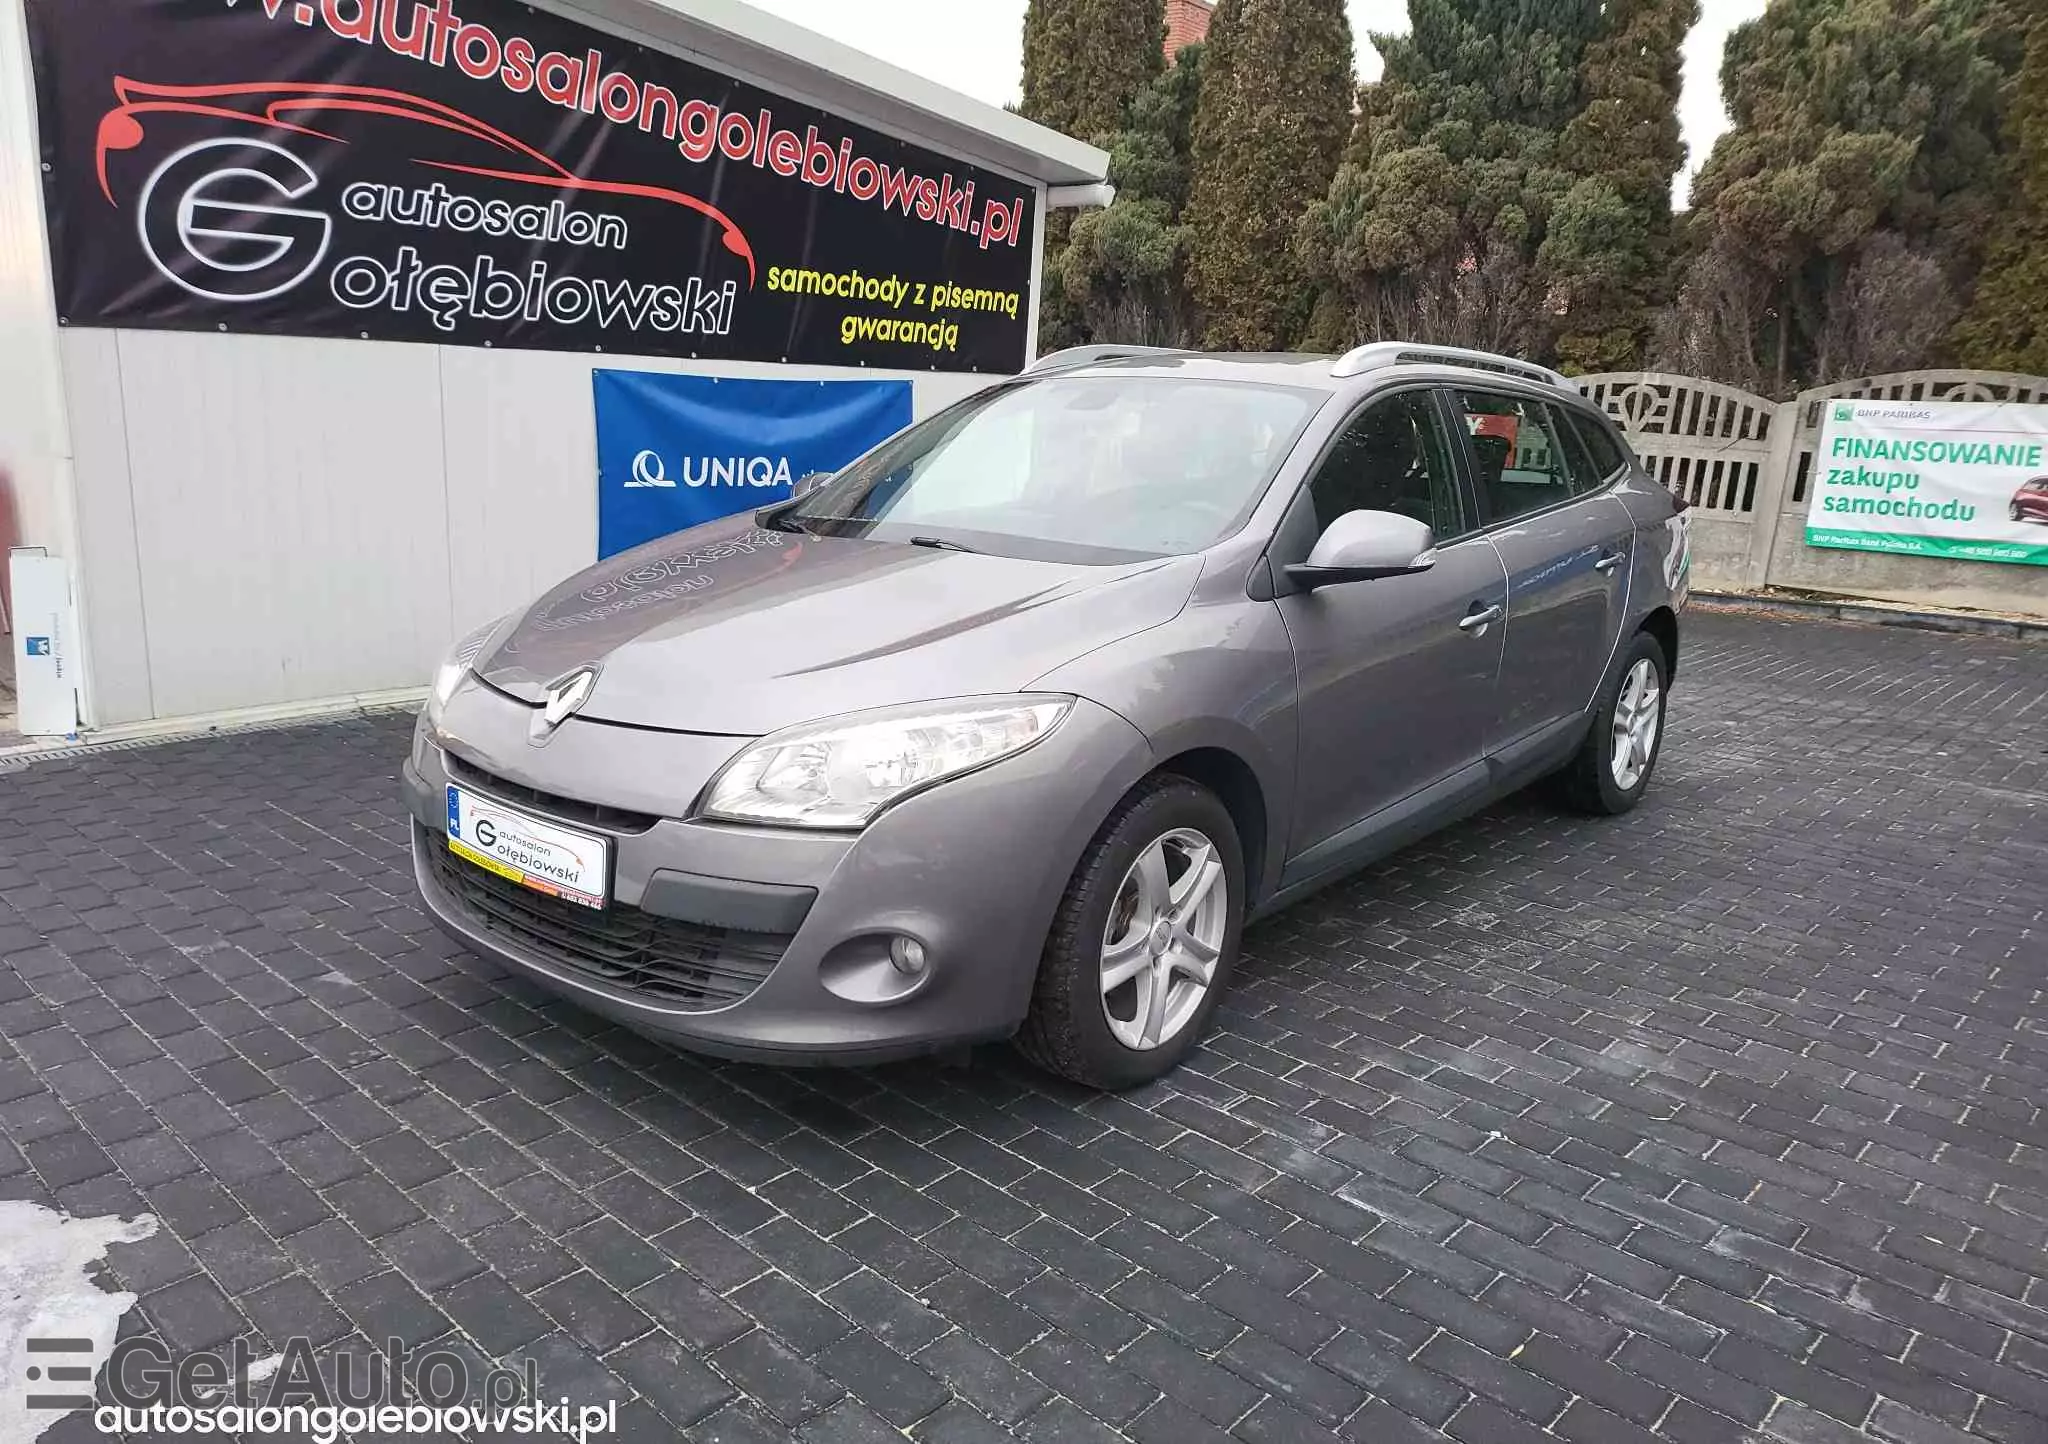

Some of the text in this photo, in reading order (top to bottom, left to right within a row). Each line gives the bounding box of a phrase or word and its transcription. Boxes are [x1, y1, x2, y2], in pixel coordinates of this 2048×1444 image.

[341, 182, 628, 250] autosalon
[767, 264, 1019, 319] samochody z pisemną
[841, 314, 959, 352] gwarancją
[1831, 437, 2043, 467] FINANSOWANIE
[683, 456, 793, 487] UNIQA
[1826, 465, 1920, 493] zakupu
[1823, 495, 1976, 522] samochodu
[499, 830, 551, 856] autosalon
